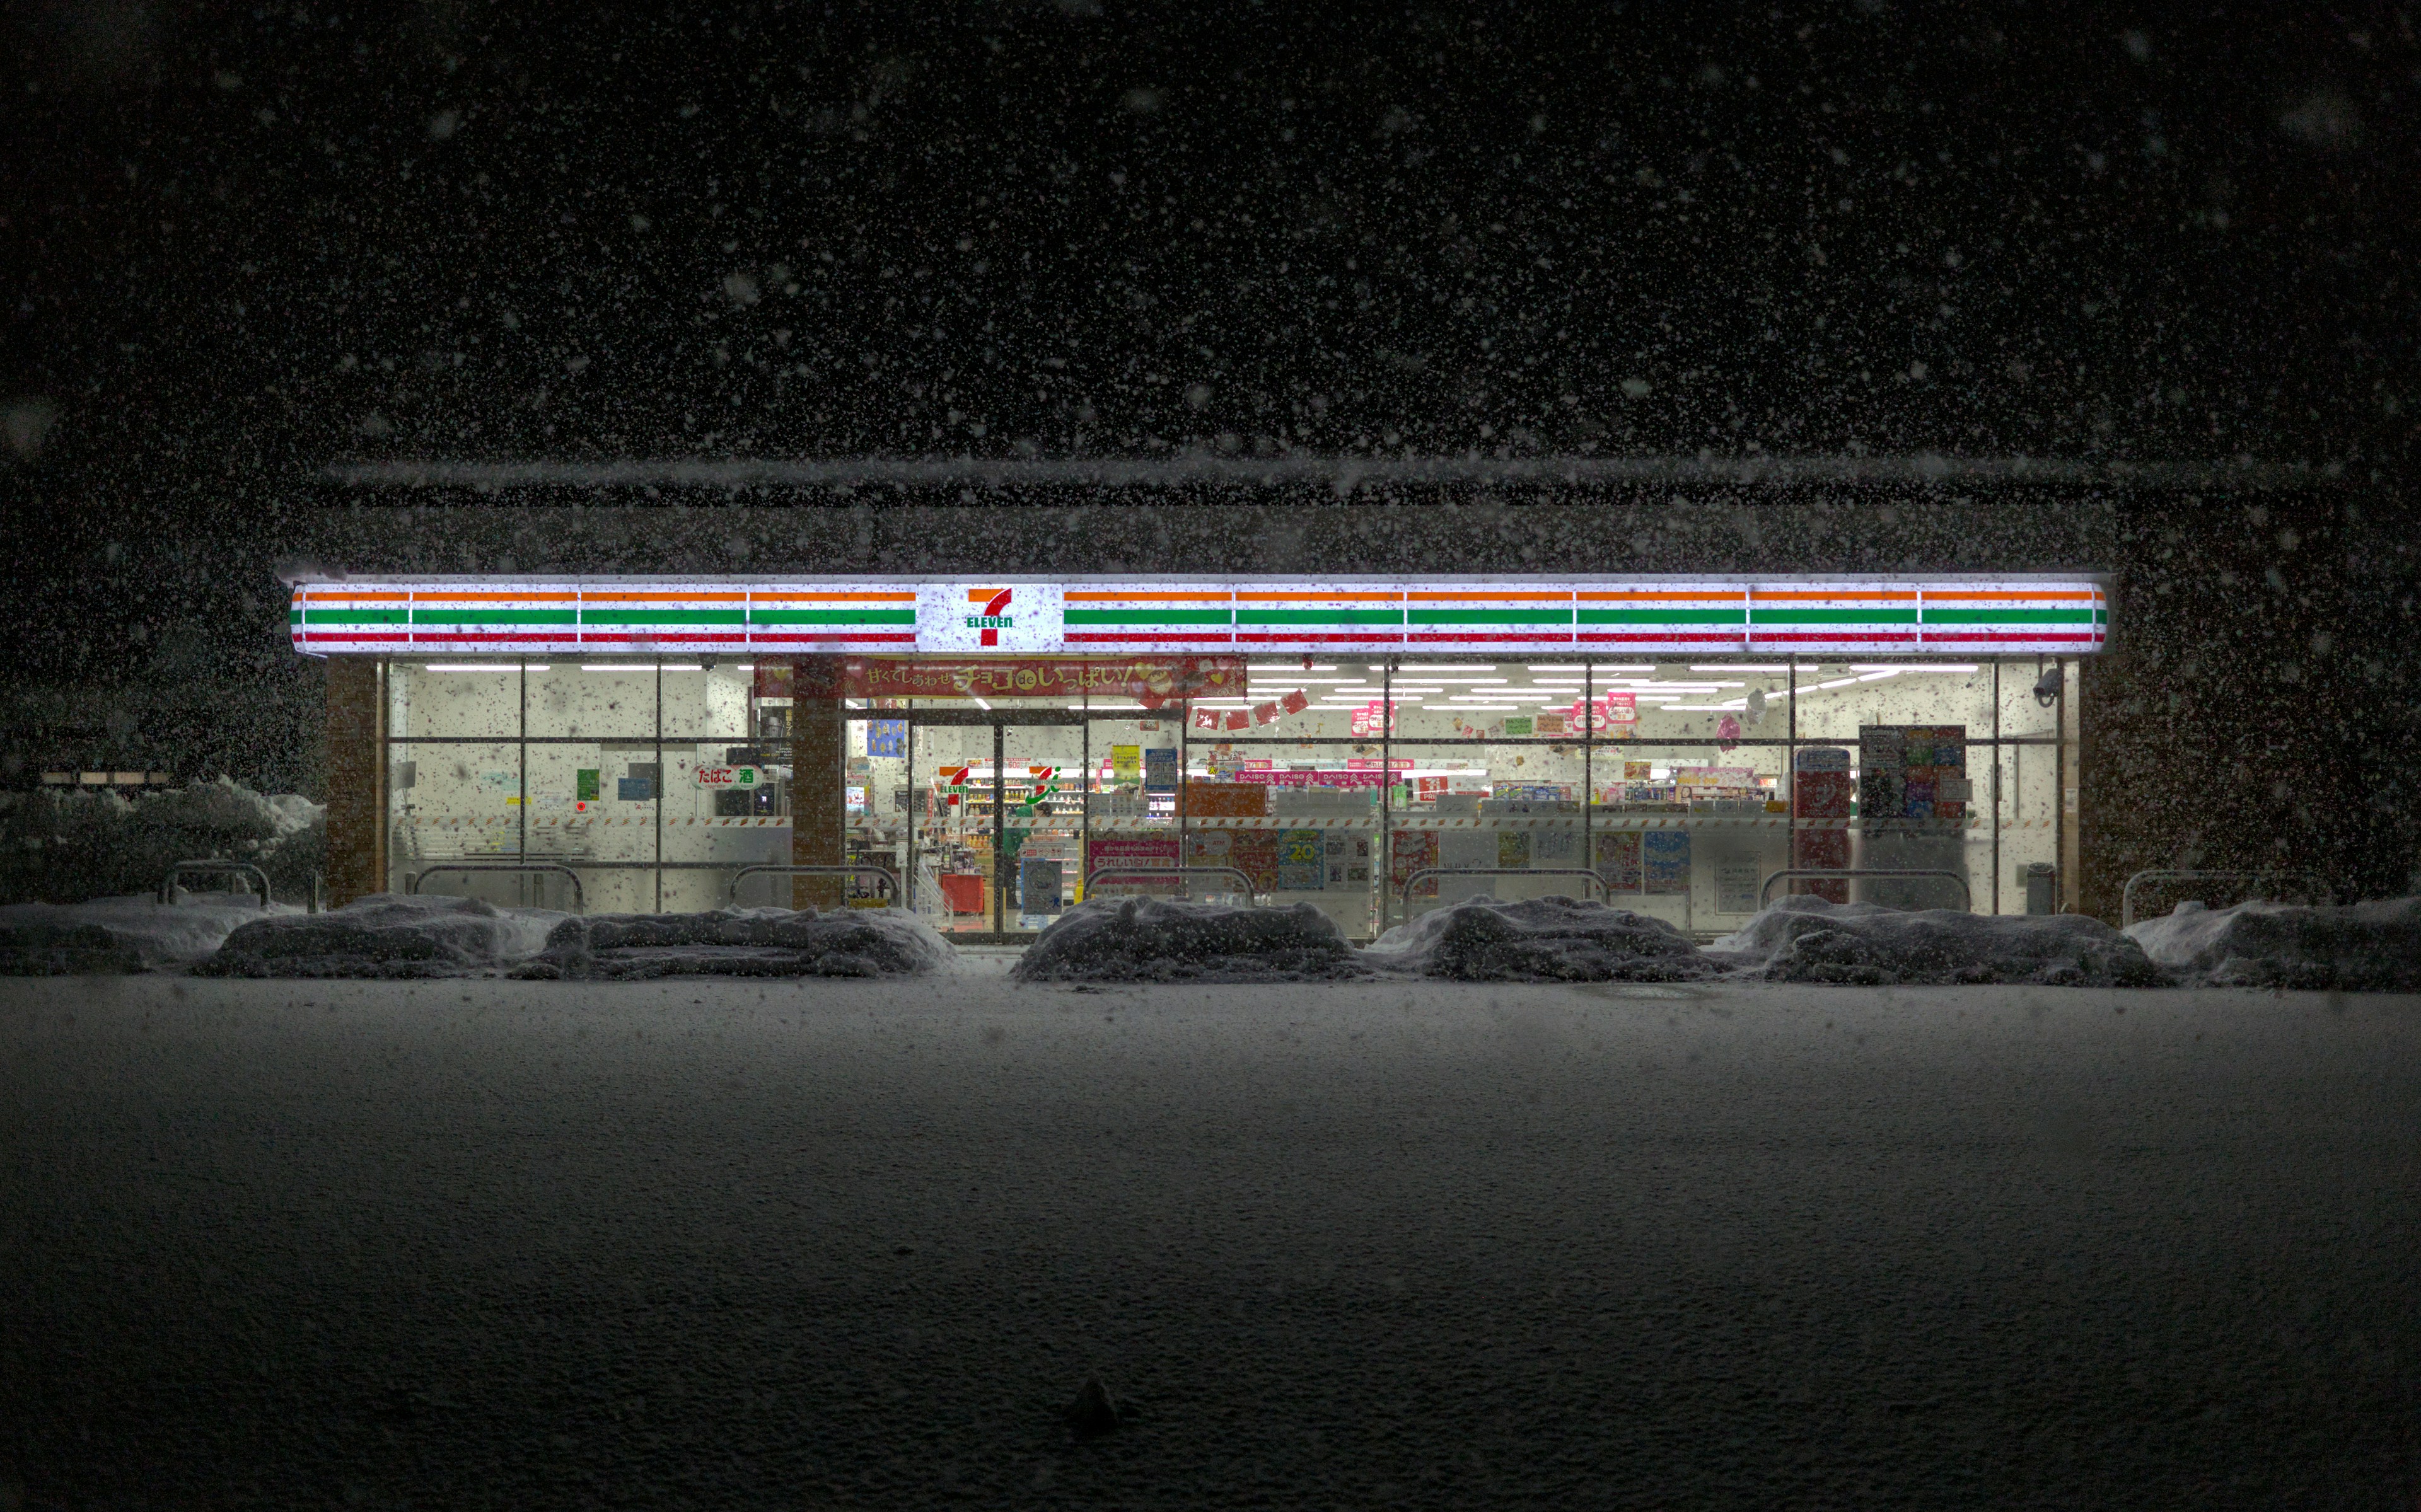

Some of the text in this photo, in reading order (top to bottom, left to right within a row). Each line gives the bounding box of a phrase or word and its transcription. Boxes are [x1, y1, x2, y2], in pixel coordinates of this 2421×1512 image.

[968, 587, 1012, 646] 7
[866, 667, 951, 687] 甘くてしあわせ
[699, 768, 754, 783] たばこ 酒
[1288, 843, 1315, 860] 20
